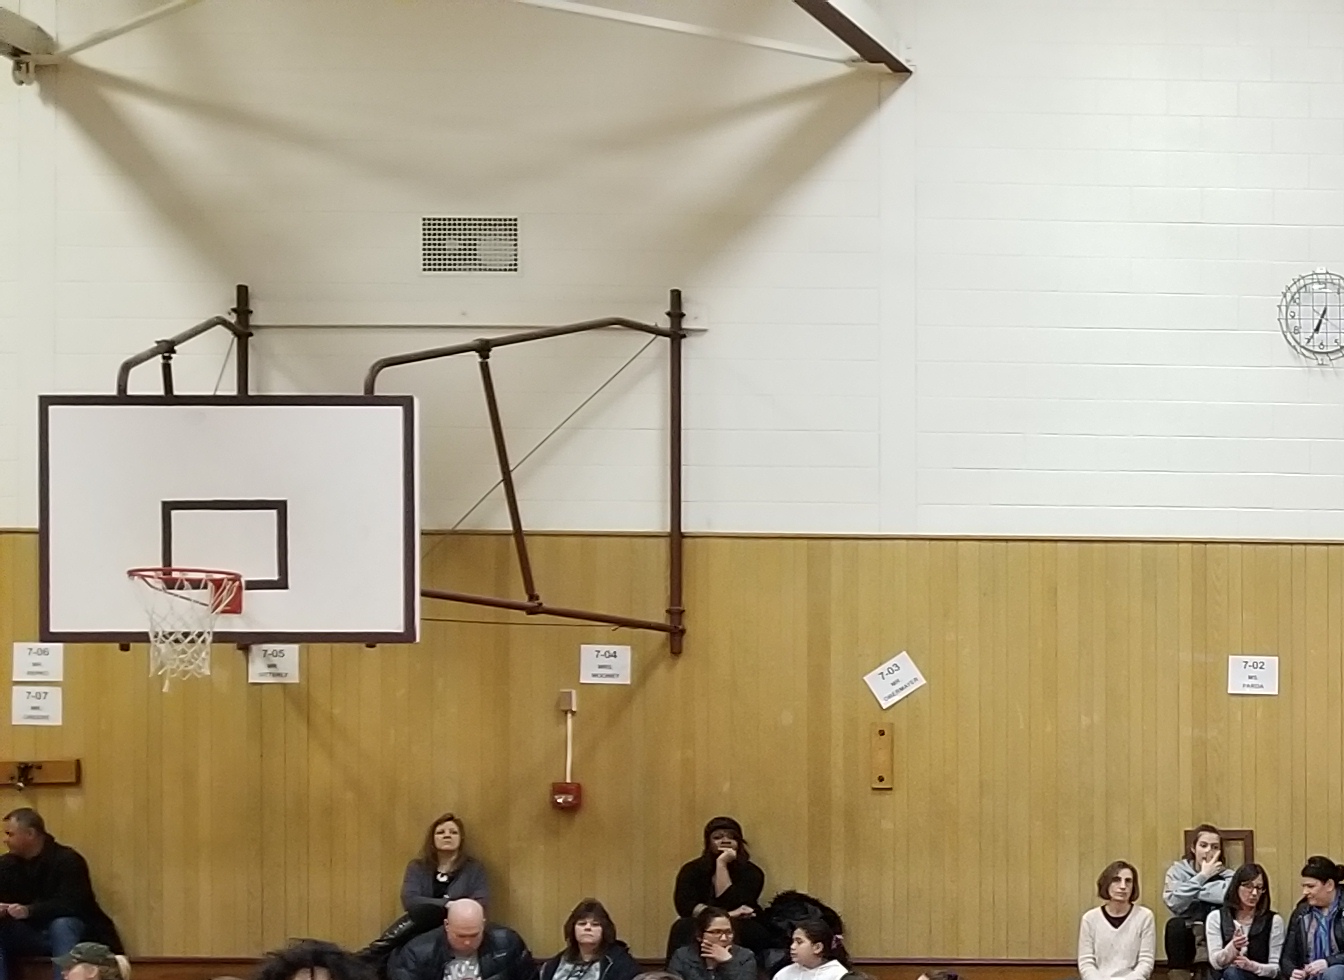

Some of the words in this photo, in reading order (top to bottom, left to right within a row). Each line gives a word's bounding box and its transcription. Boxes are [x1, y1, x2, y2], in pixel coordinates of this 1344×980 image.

[262, 649, 285, 658] 7-05
[595, 650, 618, 659] 7-04
[1242, 661, 1266, 670] 7-02
[878, 663, 901, 681] 7-03
[26, 691, 49, 700] 7-07
